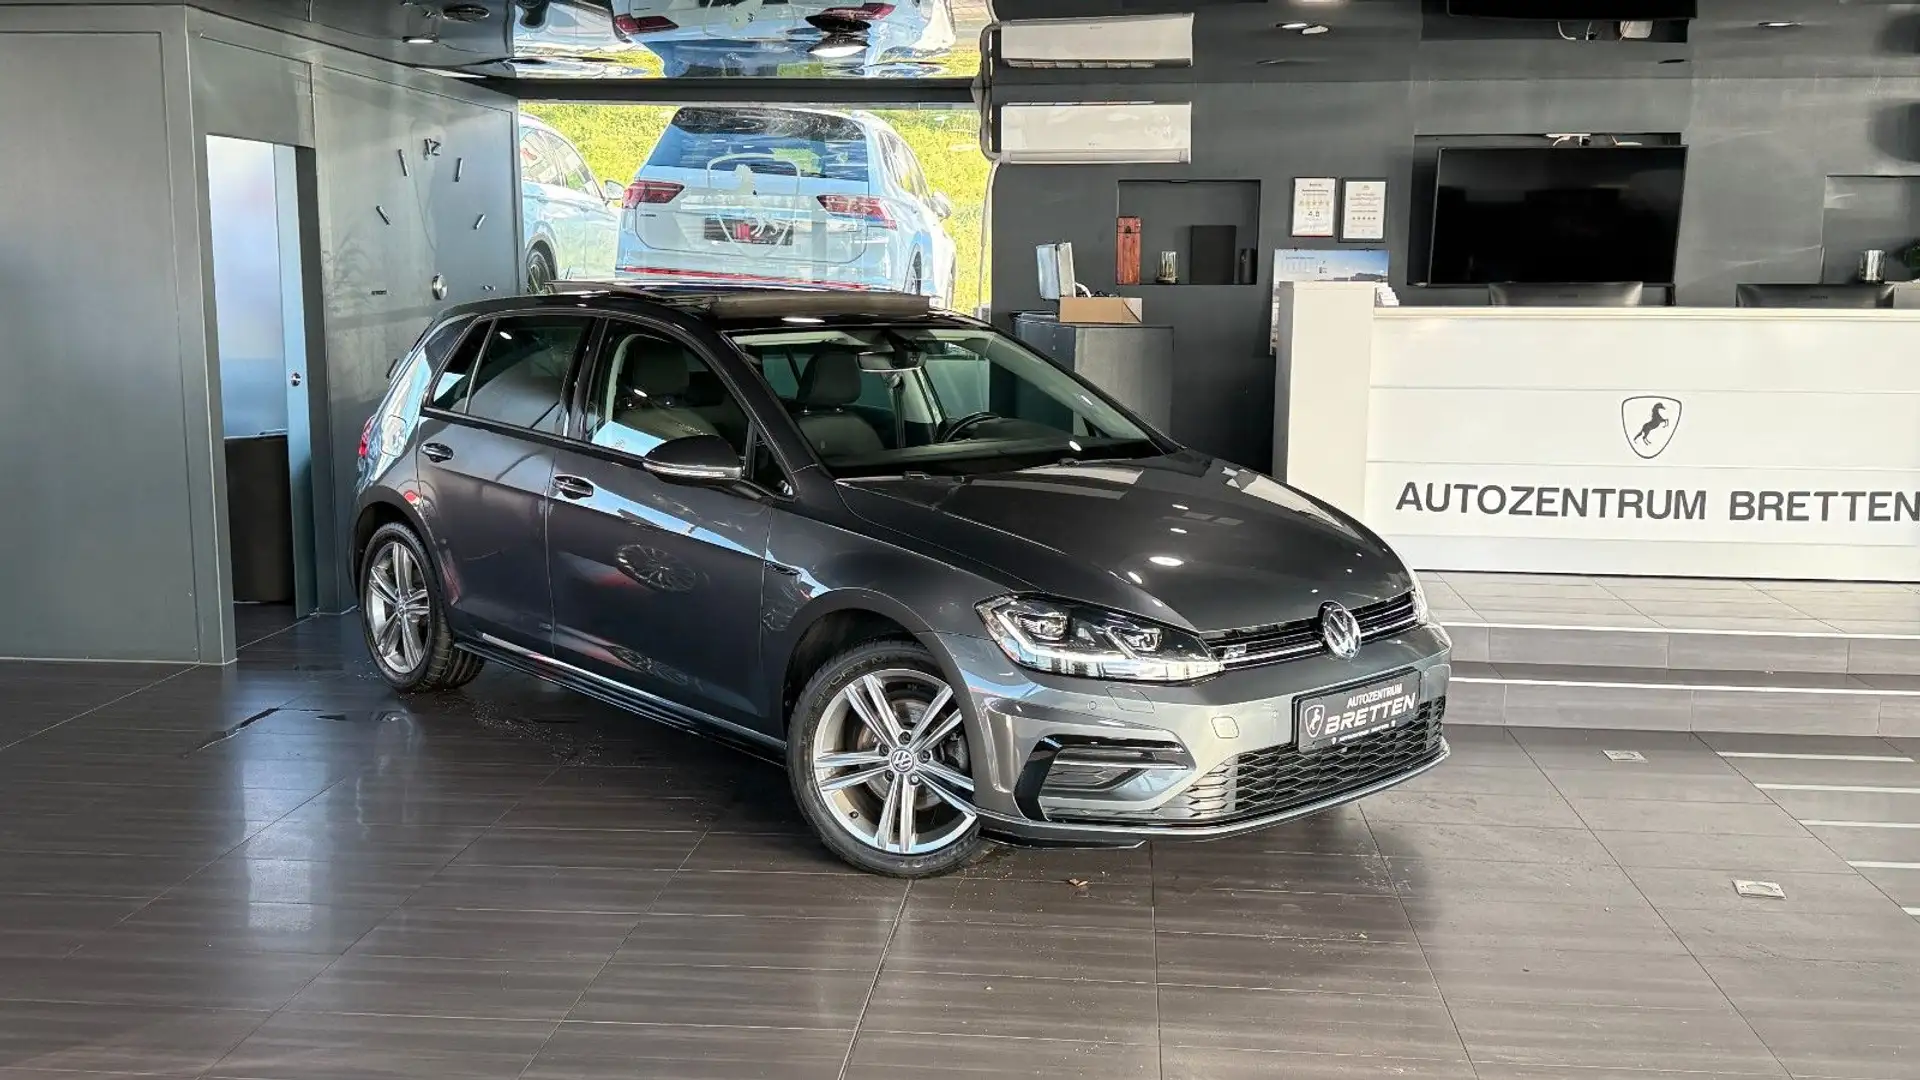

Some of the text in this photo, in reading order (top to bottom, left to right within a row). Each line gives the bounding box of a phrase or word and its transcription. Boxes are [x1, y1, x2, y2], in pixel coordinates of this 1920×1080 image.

[1396, 481, 1920, 522] AUTOZENTRUM BRETTEN
[1324, 692, 1416, 735] BRETTEN
[1346, 683, 1403, 709] AUTOZENTRUM
